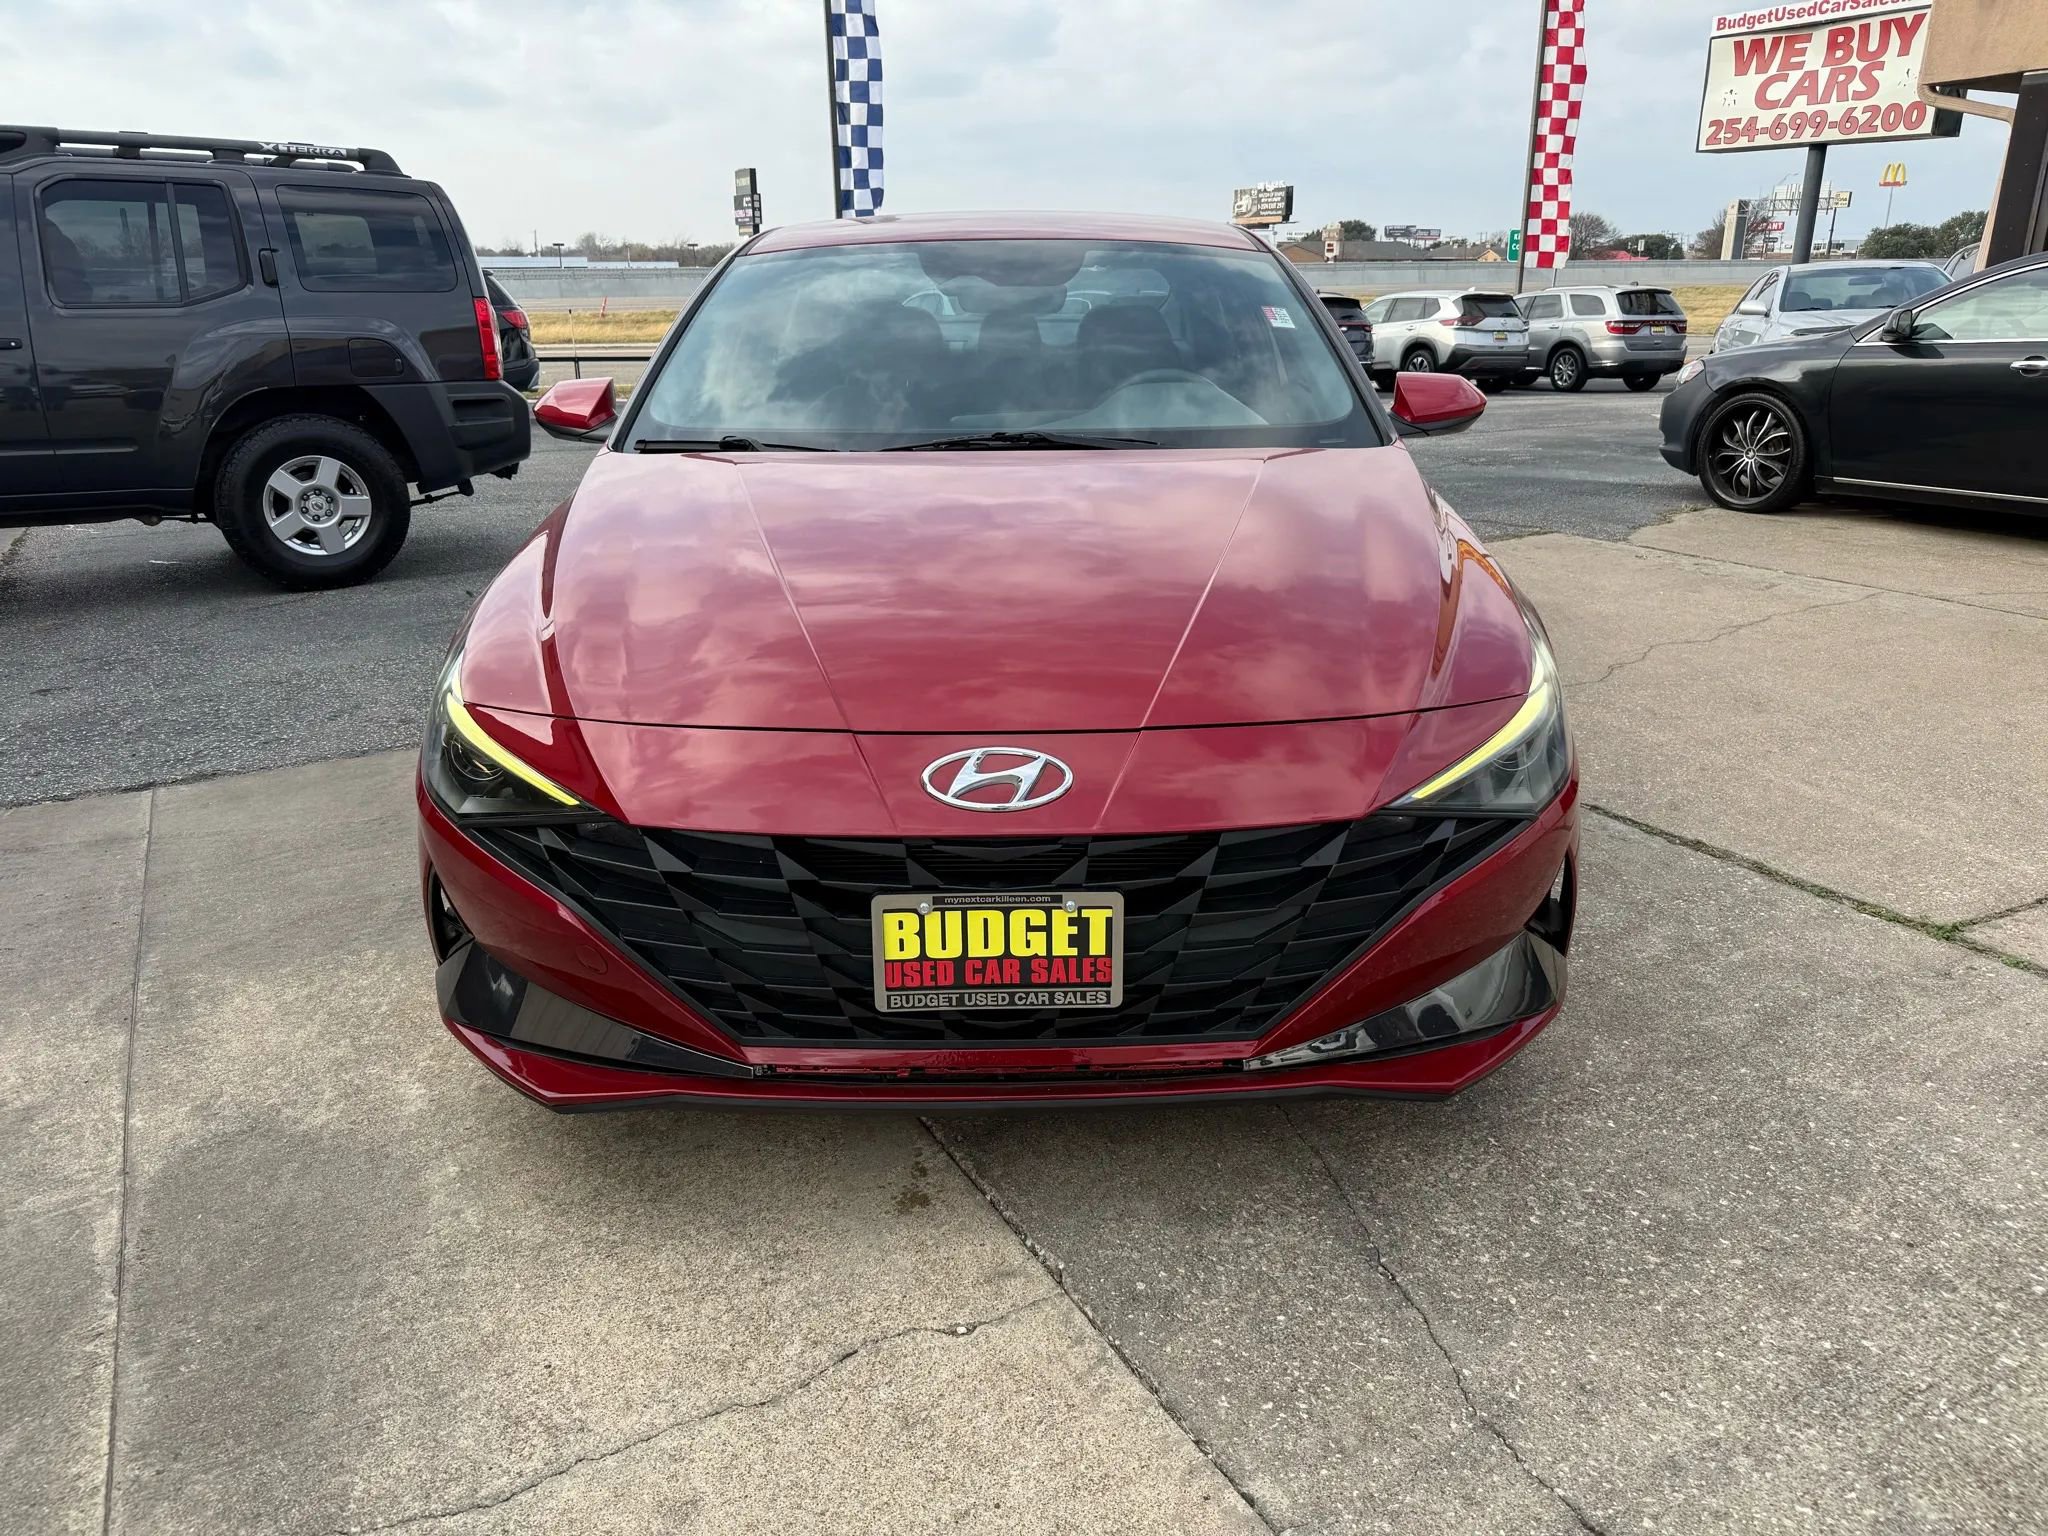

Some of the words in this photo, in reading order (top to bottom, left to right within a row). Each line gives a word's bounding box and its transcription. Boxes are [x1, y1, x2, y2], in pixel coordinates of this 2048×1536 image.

[1733, 32, 1813, 77] WE
[1821, 12, 1928, 68] BUY
[1754, 60, 1886, 110] CARS
[1705, 101, 1927, 146] 254-699-6200
[258, 142, 346, 158] XTERRA
[944, 895, 1051, 904] mynextcarkilleen.com
[883, 909, 1113, 960] BUDGET
[884, 961, 955, 988] USED
[965, 958, 1021, 985] CAR
[1031, 957, 1113, 984] SALES
[890, 993, 960, 1008] BUDGET
[964, 993, 1009, 1006] USED
[1014, 992, 1049, 1006] CAR
[1053, 991, 1107, 1005] SALES
